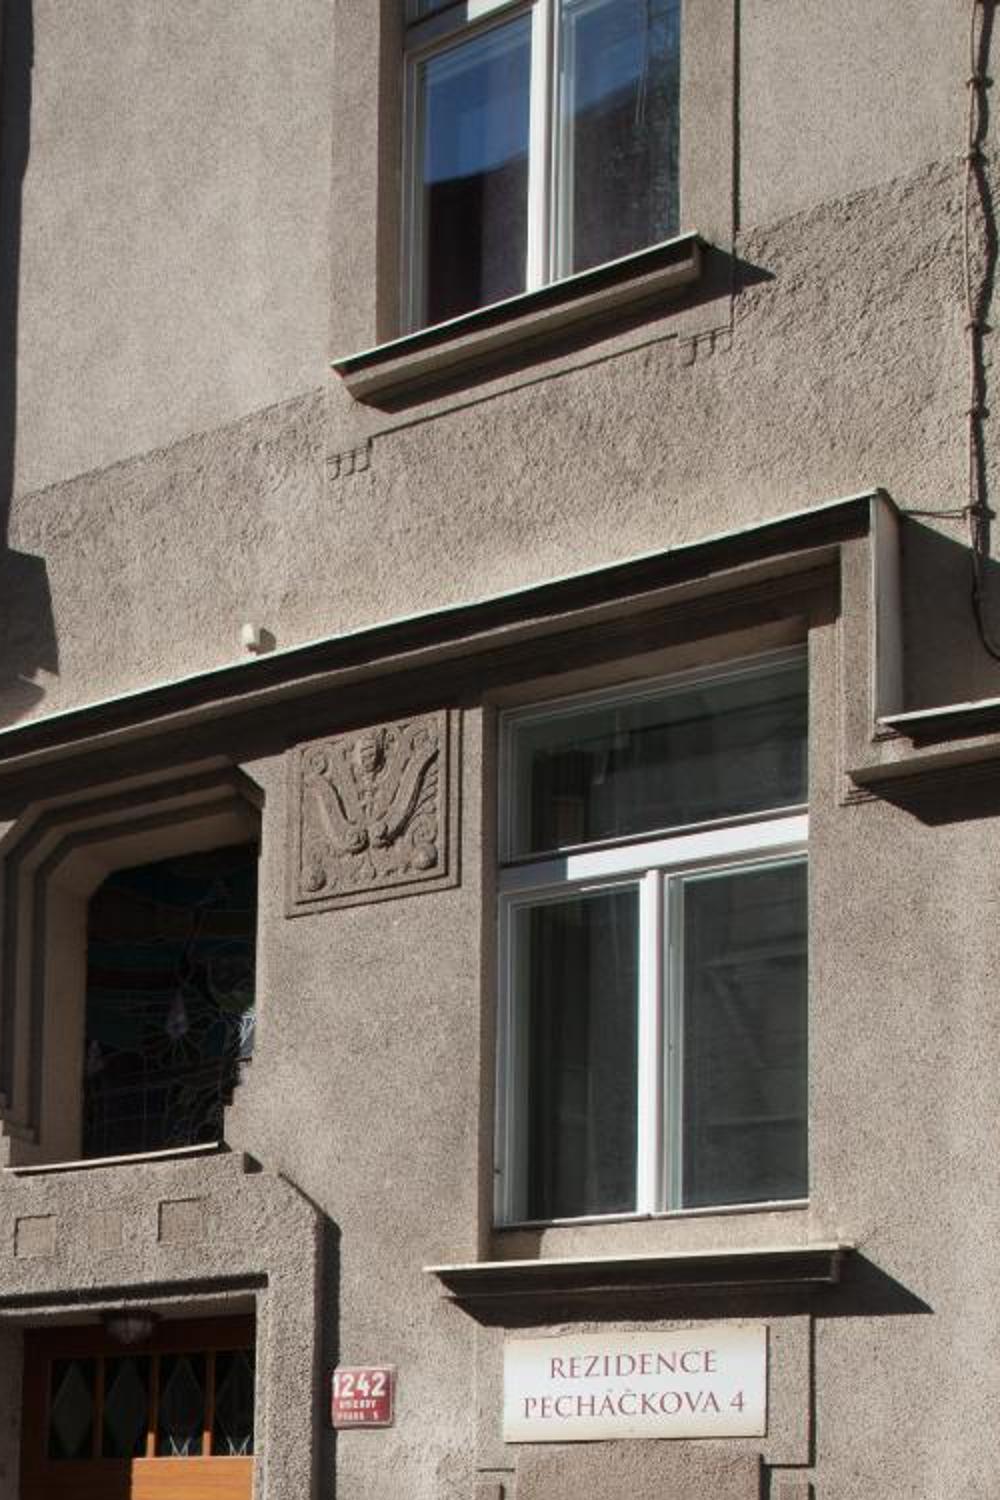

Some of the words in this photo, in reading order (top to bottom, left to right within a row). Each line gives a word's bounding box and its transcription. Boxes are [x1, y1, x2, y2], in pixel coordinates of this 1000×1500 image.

[550, 1350, 718, 1380] REZIDENCE
[523, 1388, 721, 1420] PECHÁČKOVA
[730, 1390, 745, 1413] 4
